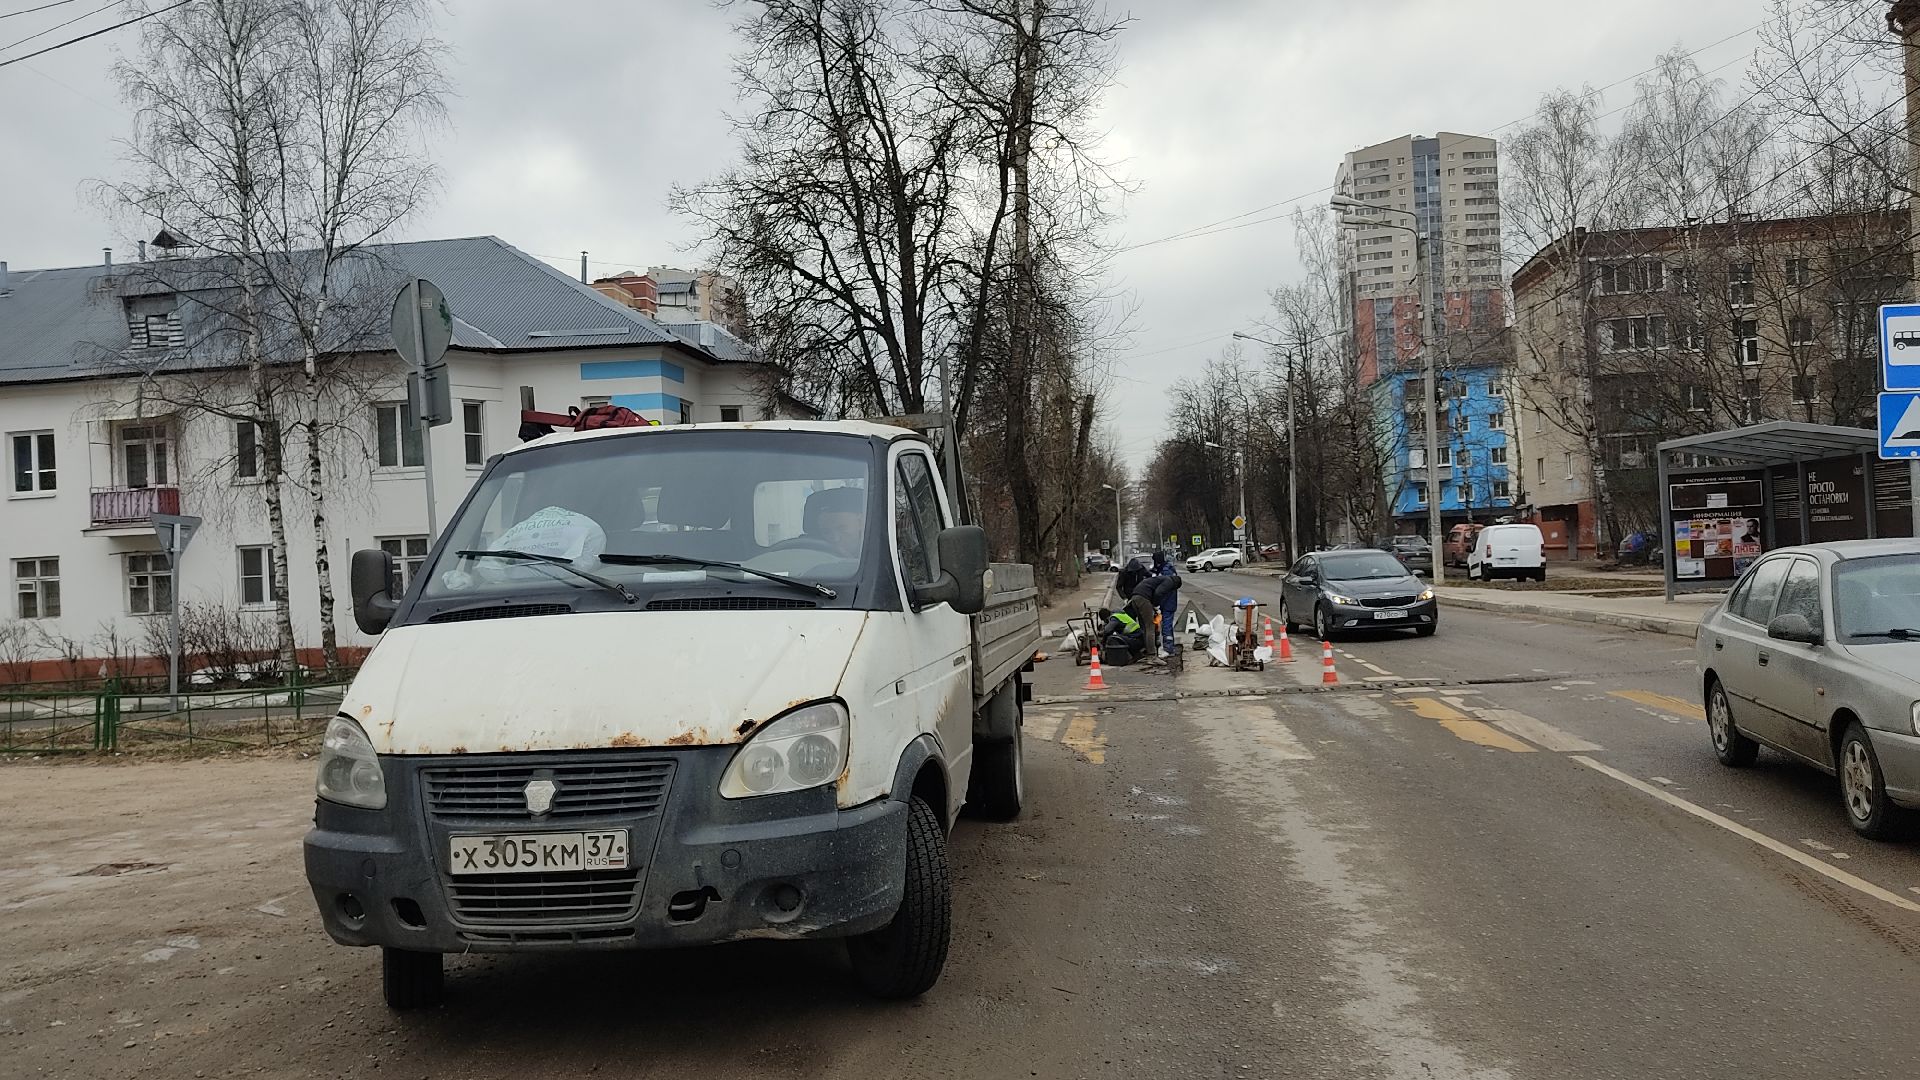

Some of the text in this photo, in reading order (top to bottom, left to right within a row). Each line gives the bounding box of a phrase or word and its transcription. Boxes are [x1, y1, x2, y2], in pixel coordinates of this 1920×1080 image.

[1808, 472, 1818, 483] НЕ
[1809, 481, 1835, 493] ПРОСТО
[1809, 491, 1849, 505] ОСТАНОВКИ
[1693, 511, 1743, 519] ИНФОРМАЦИЯ
[462, 835, 616, 869] Х305КМ 37
[586, 857, 608, 866] RUS
